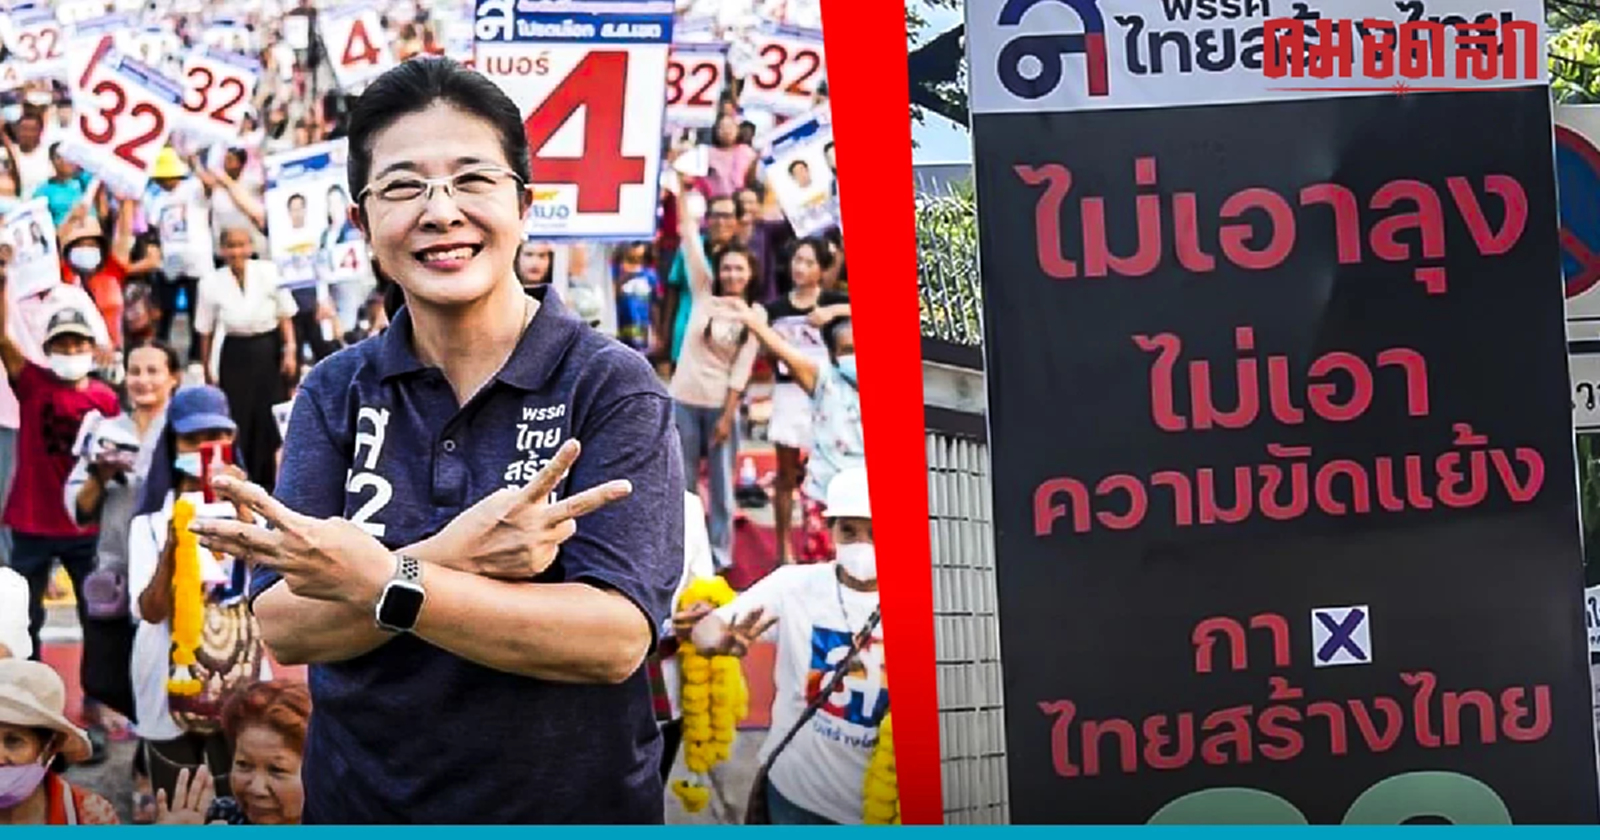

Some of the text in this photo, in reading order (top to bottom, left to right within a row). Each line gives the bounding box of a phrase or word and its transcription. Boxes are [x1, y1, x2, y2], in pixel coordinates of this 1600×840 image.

[18, 28, 64, 63] 32
[341, 19, 381, 66] 4
[487, 51, 550, 76] เบอร์
[755, 44, 821, 97] 32
[182, 67, 244, 124] 32
[667, 62, 719, 107] 32
[80, 81, 164, 170] 32
[525, 51, 645, 213] 4
[1013, 156, 1529, 294] ไม่เอาลุง
[1131, 327, 1429, 432] ไม่เอา
[516, 424, 561, 451] ไทย
[522, 403, 565, 421] พรรค
[504, 449, 569, 481] สร้
[1033, 423, 1545, 536] ความขัดแย้ง
[345, 468, 393, 537] 2
[1191, 612, 1292, 673] กา
[1039, 672, 1552, 778] ไทยสร้างไทย
